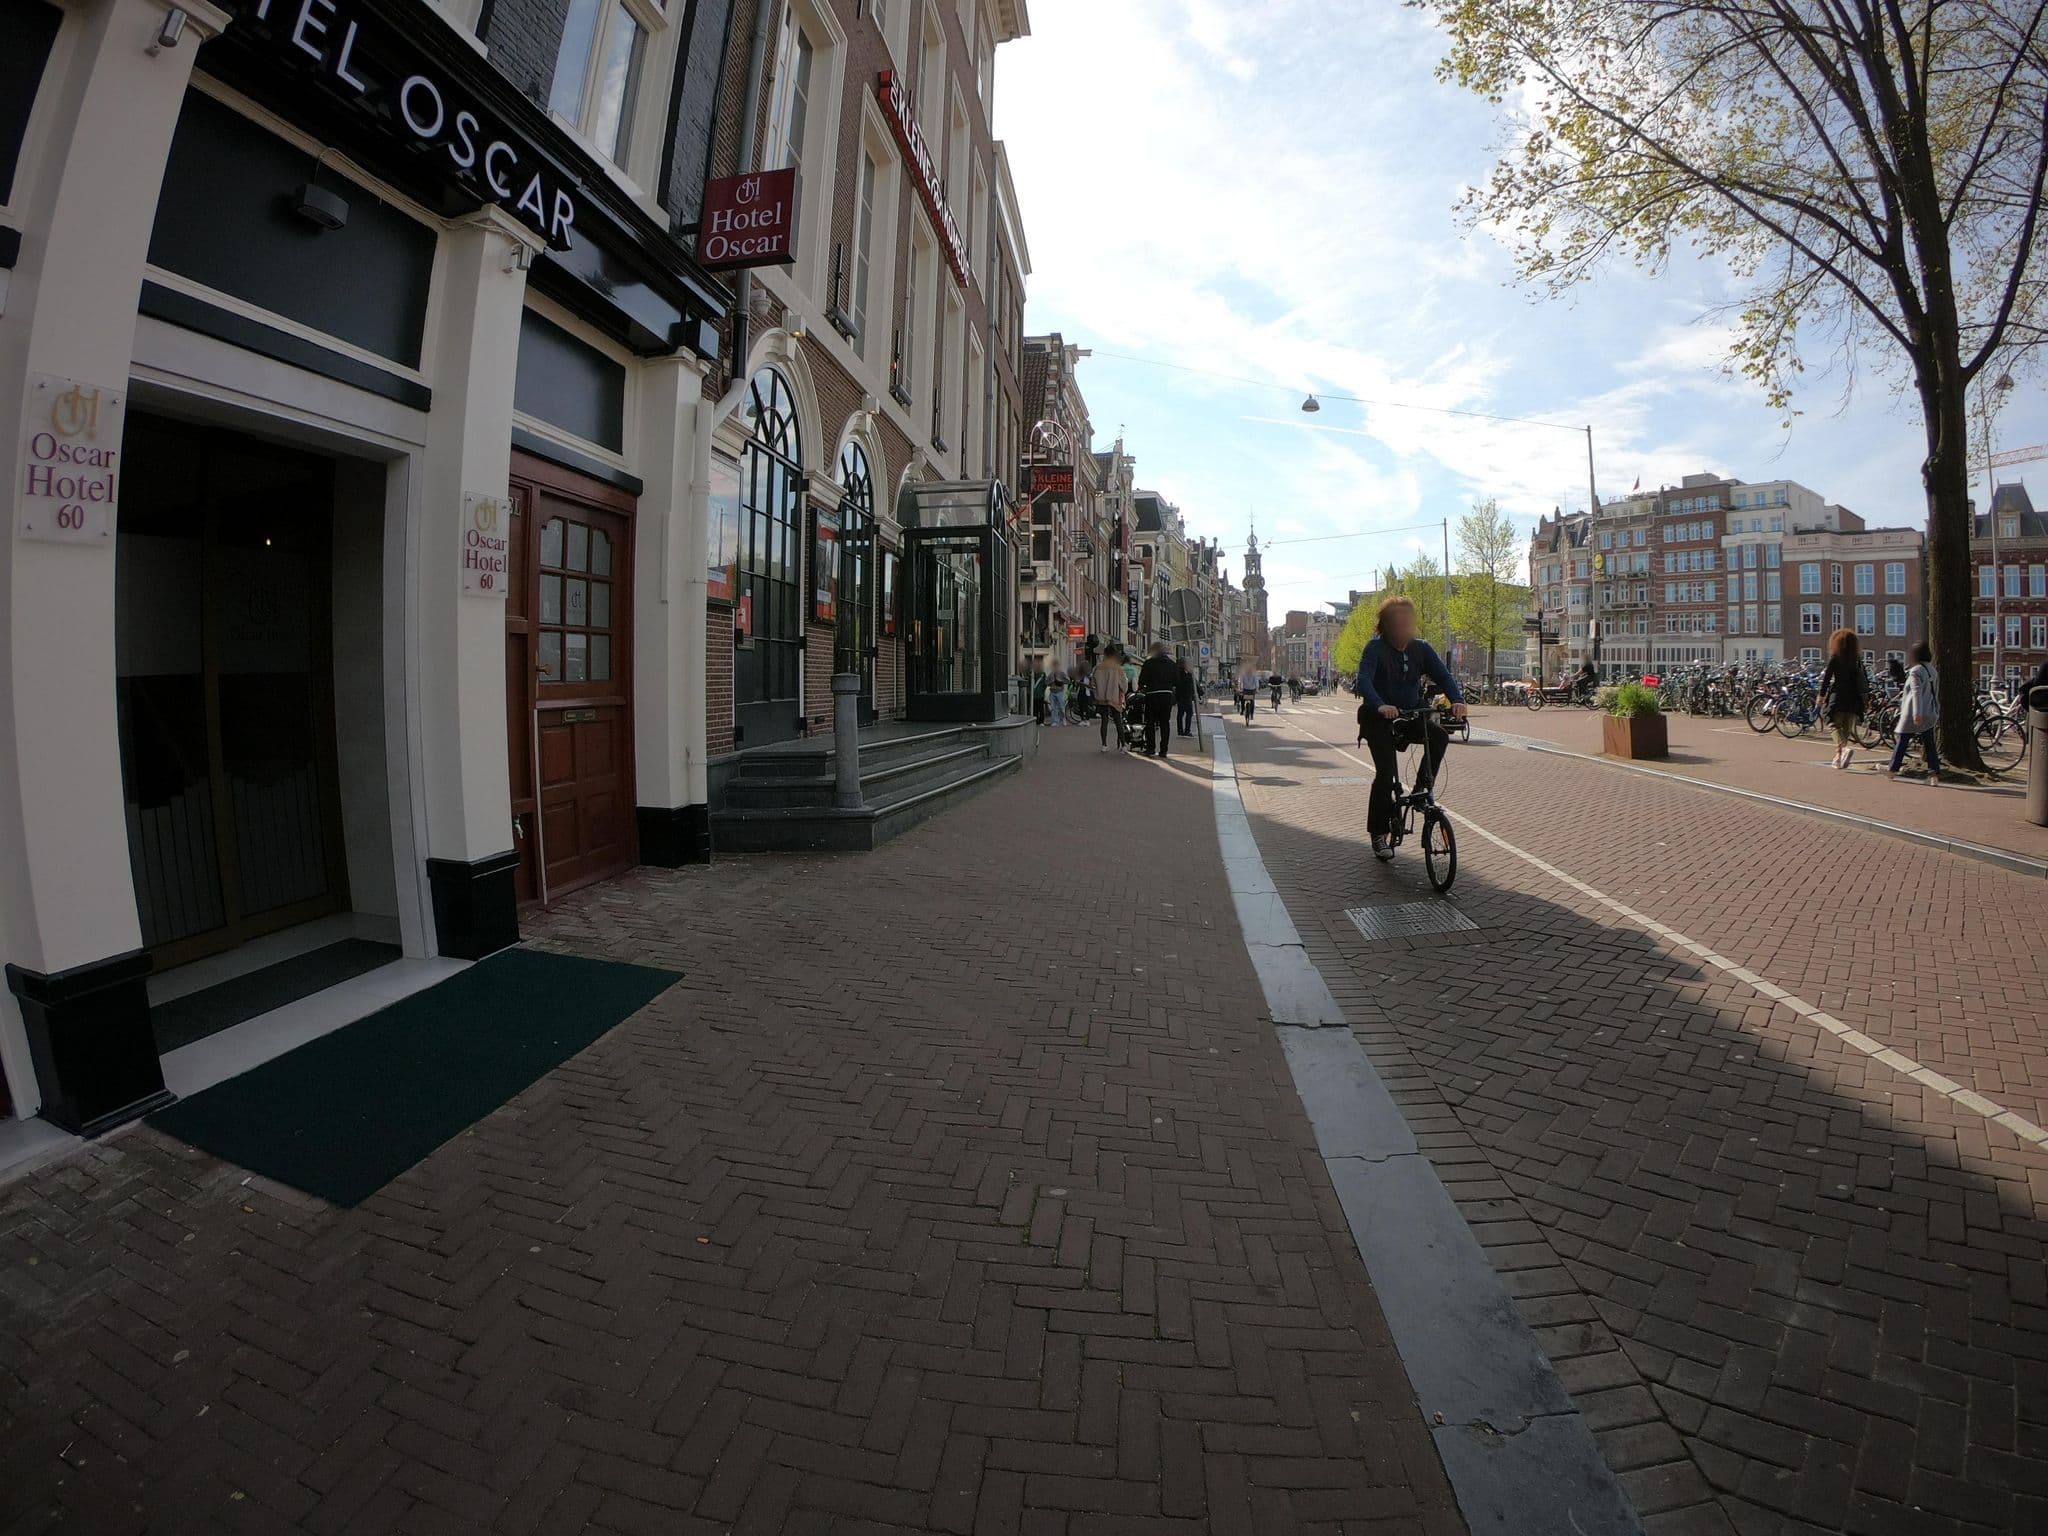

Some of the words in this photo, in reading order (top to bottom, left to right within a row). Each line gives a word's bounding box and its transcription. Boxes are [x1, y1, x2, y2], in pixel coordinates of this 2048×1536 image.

[400, 75, 575, 249] OSCAR
[710, 201, 782, 234] Hotel
[705, 234, 783, 260] Oscar
[31, 432, 116, 469] Oscar
[26, 463, 116, 504] Hotel
[1038, 473, 1073, 483] KLEINE
[57, 503, 85, 530] 60
[466, 529, 508, 552] Oscar
[464, 548, 508, 574] Hotel
[479, 573, 494, 590] 60
